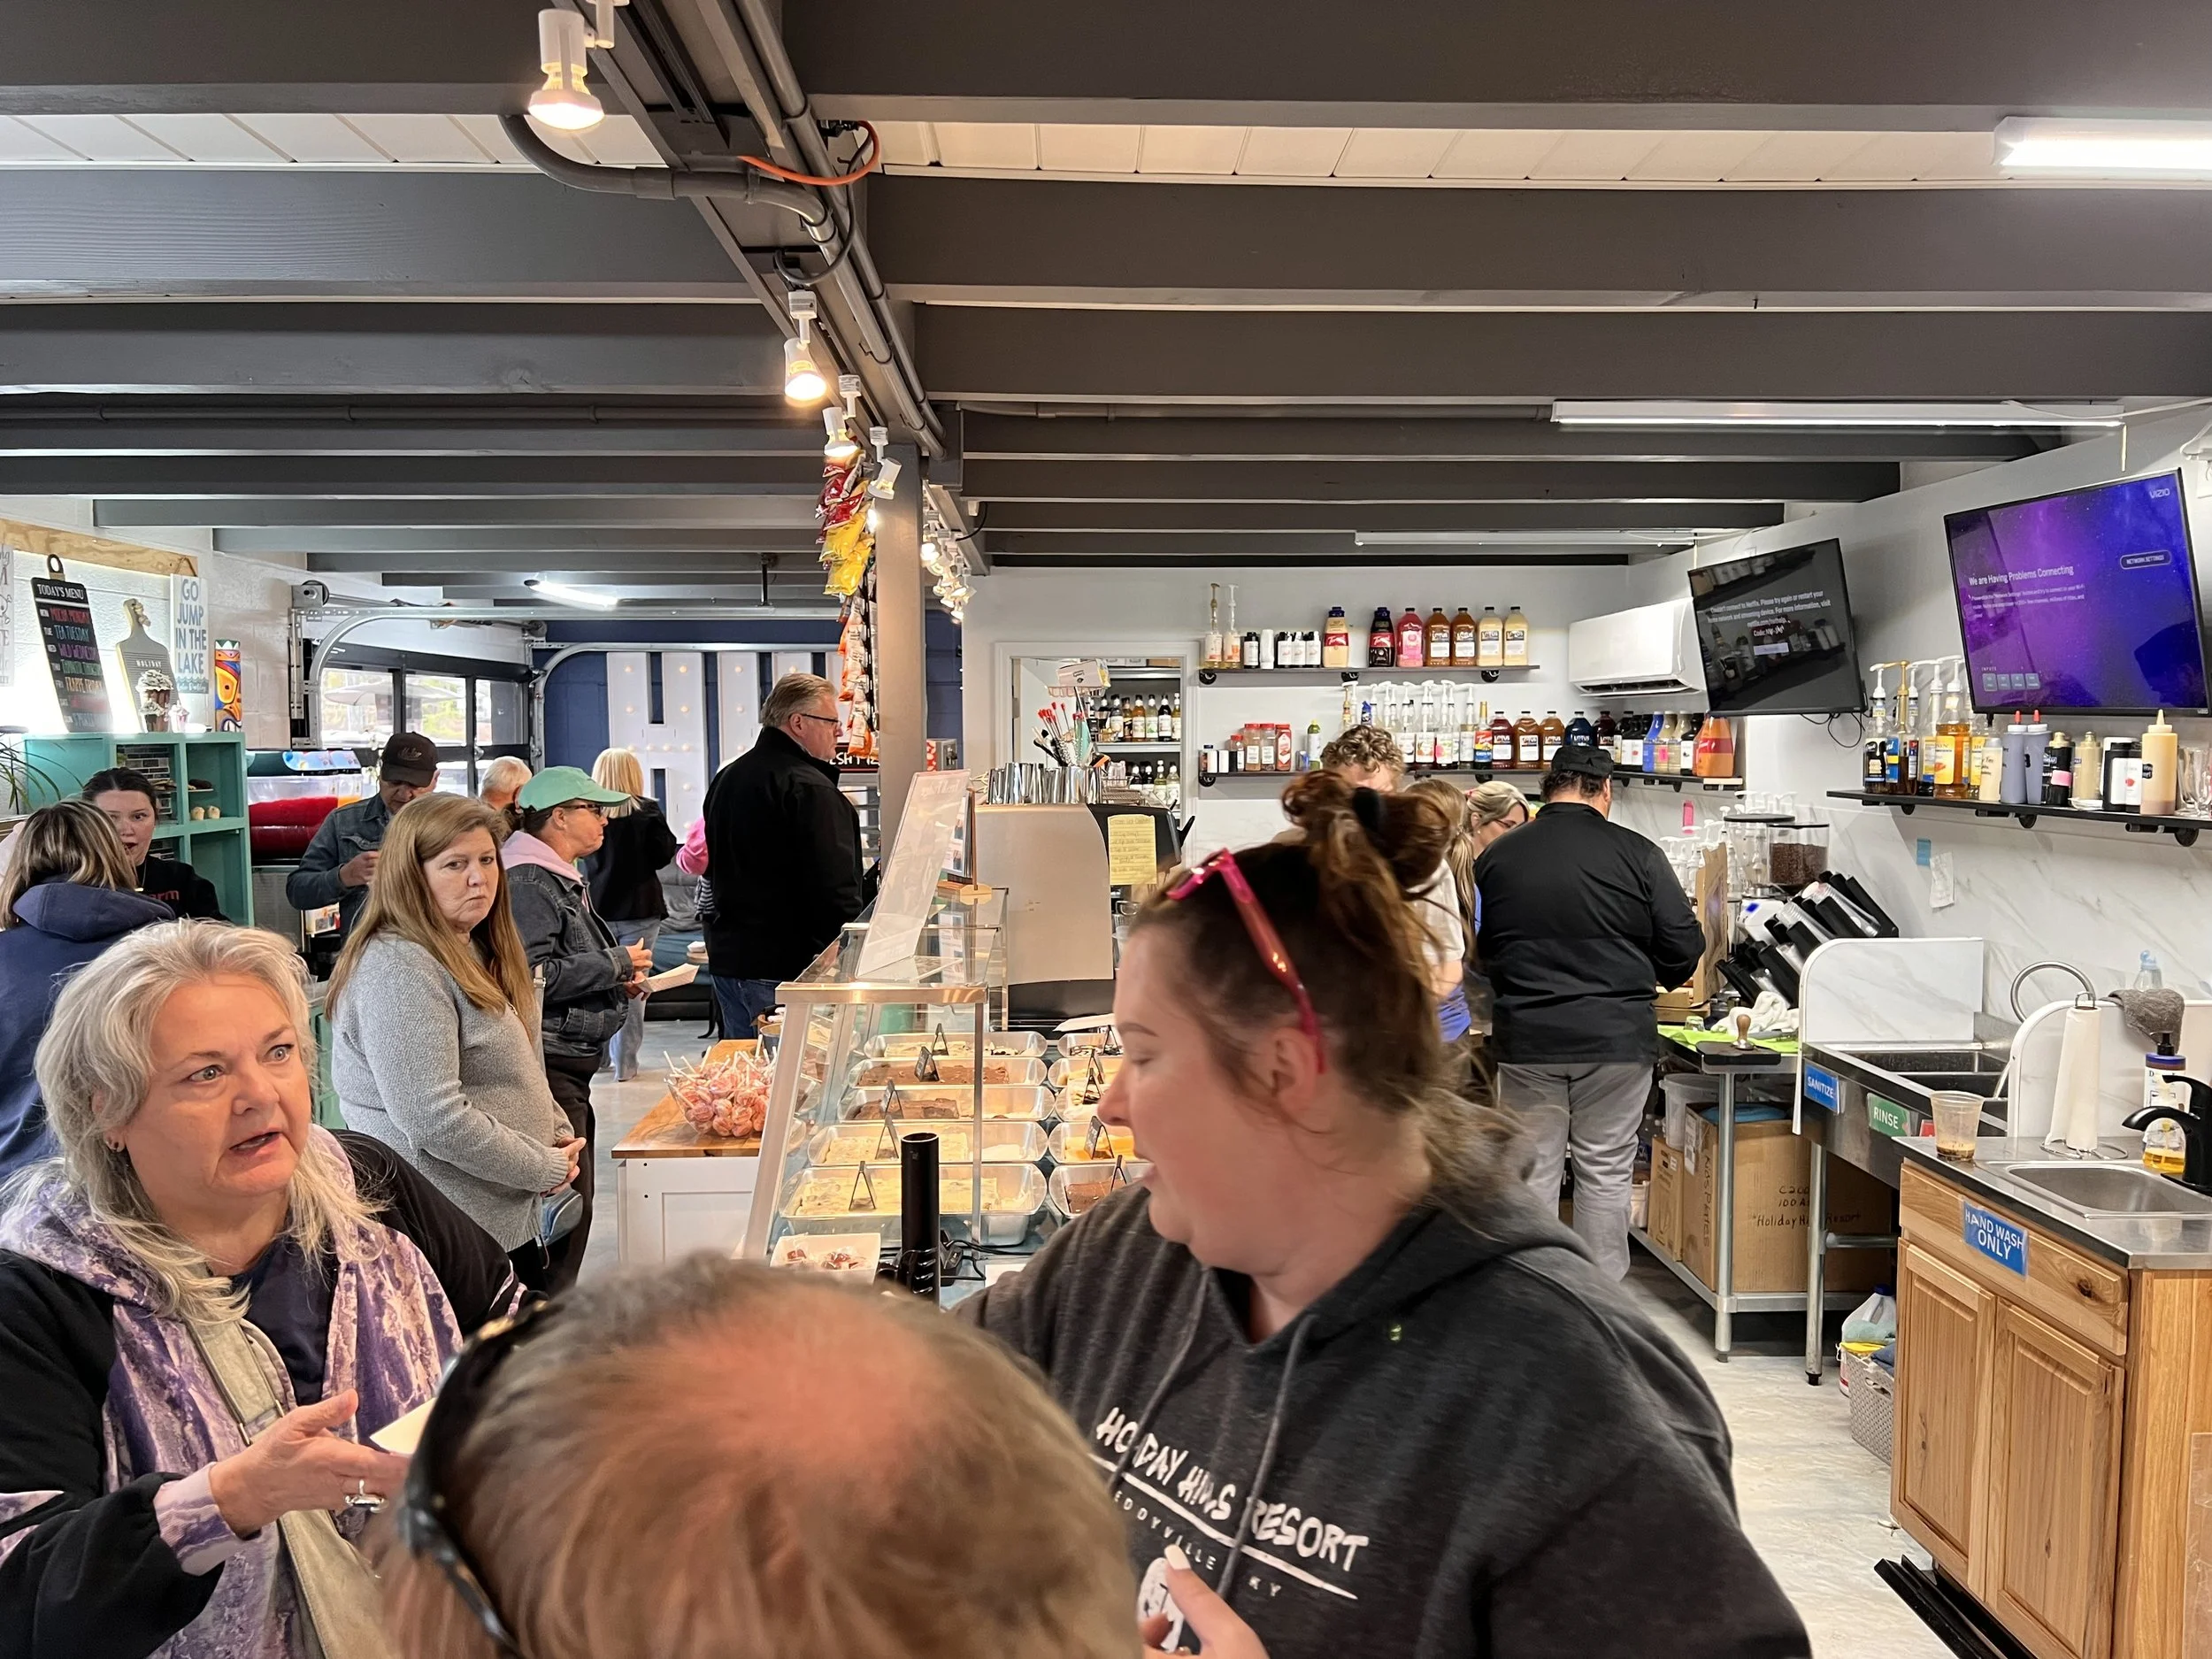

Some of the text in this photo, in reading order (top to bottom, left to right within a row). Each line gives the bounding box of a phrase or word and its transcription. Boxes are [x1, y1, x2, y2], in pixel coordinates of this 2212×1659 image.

[2149, 488, 2170, 499] VIZIO
[1969, 577, 1978, 586] We
[1988, 574, 2008, 584] Having
[2008, 570, 2036, 580] Problems
[2037, 566, 2074, 578] Connecting
[36, 584, 84, 600] TODAY'S MENU
[181, 579, 199, 602] GO
[177, 603, 204, 626] JUMP
[65, 626, 89, 642] TUESDAY
[175, 627, 207, 650] IN THE
[178, 652, 204, 674] LAKE
[1807, 1076, 1835, 1099] SANITIZE
[1873, 1106, 1899, 1130] RINSE
[1778, 1198, 1797, 1207] 100
[1965, 1209, 2024, 1249] HAND WASH
[1978, 1229, 2011, 1260] ONLY
[1249, 1575, 1282, 1597] KY
